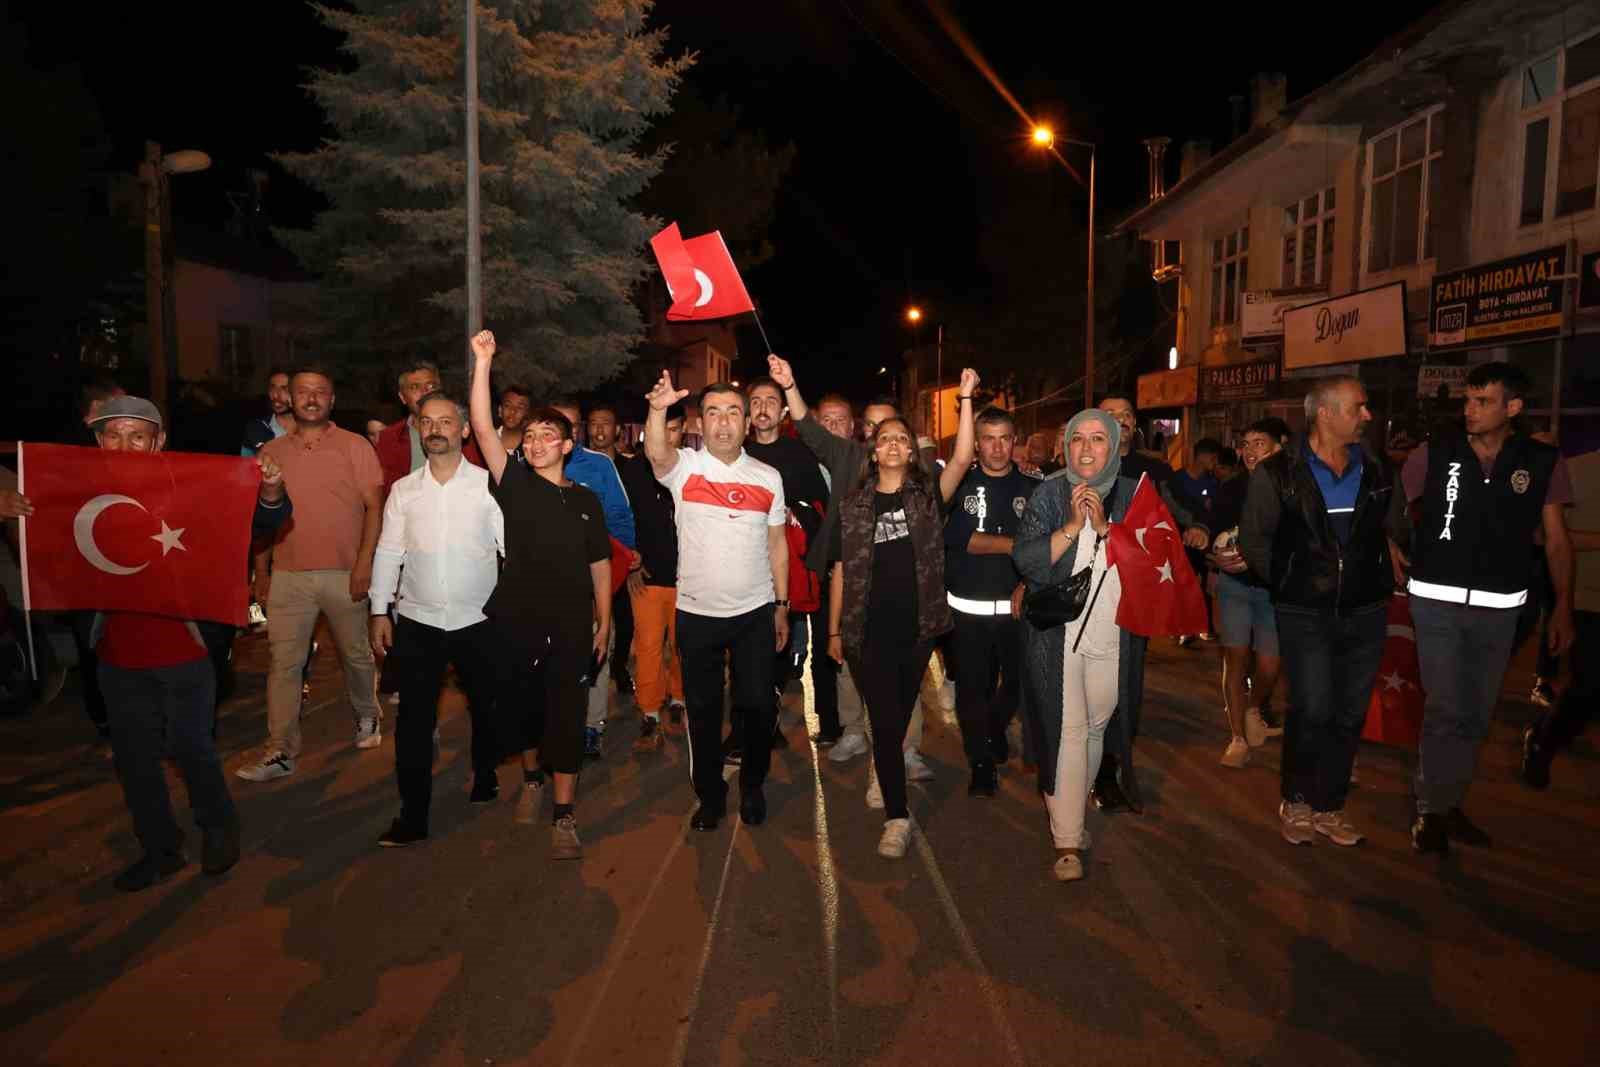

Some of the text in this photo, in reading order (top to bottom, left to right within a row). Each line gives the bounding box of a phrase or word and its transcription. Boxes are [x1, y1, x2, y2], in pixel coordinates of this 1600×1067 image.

[1436, 257, 1559, 301] FATİH HIRDAVAT
[1440, 462, 1461, 540] ZABITA
